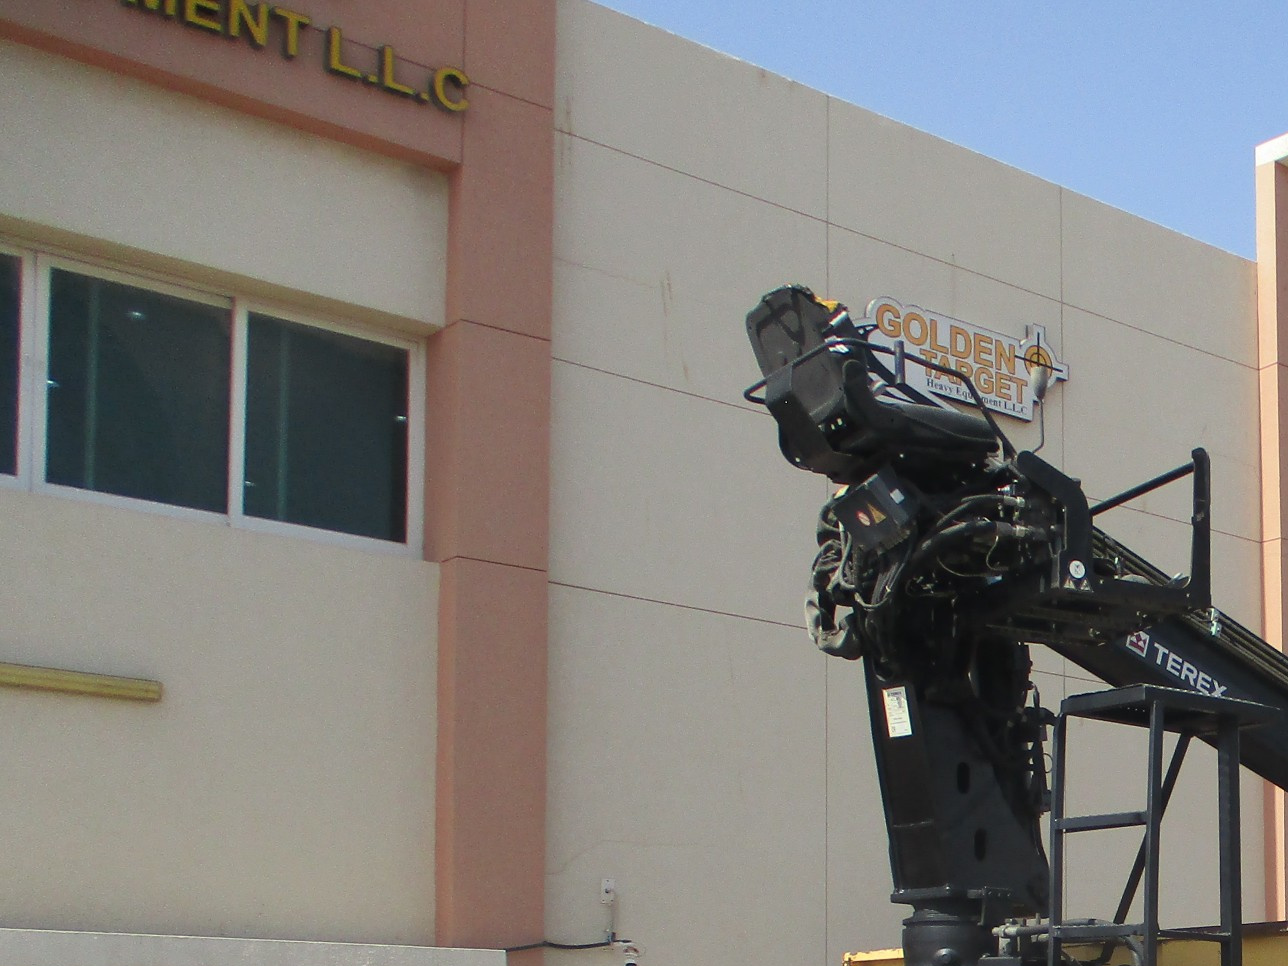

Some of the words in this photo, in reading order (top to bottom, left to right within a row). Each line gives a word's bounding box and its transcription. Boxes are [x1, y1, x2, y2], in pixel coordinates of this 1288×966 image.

[323, 26, 470, 113] L.L.C
[876, 303, 1016, 376] GOLDEN
[919, 348, 1028, 405] TARGET
[926, 378, 954, 396] Heavy
[956, 386, 1001, 407] Equment
[1004, 401, 1028, 415] L.L.C
[1153, 643, 1229, 698] TEREX
